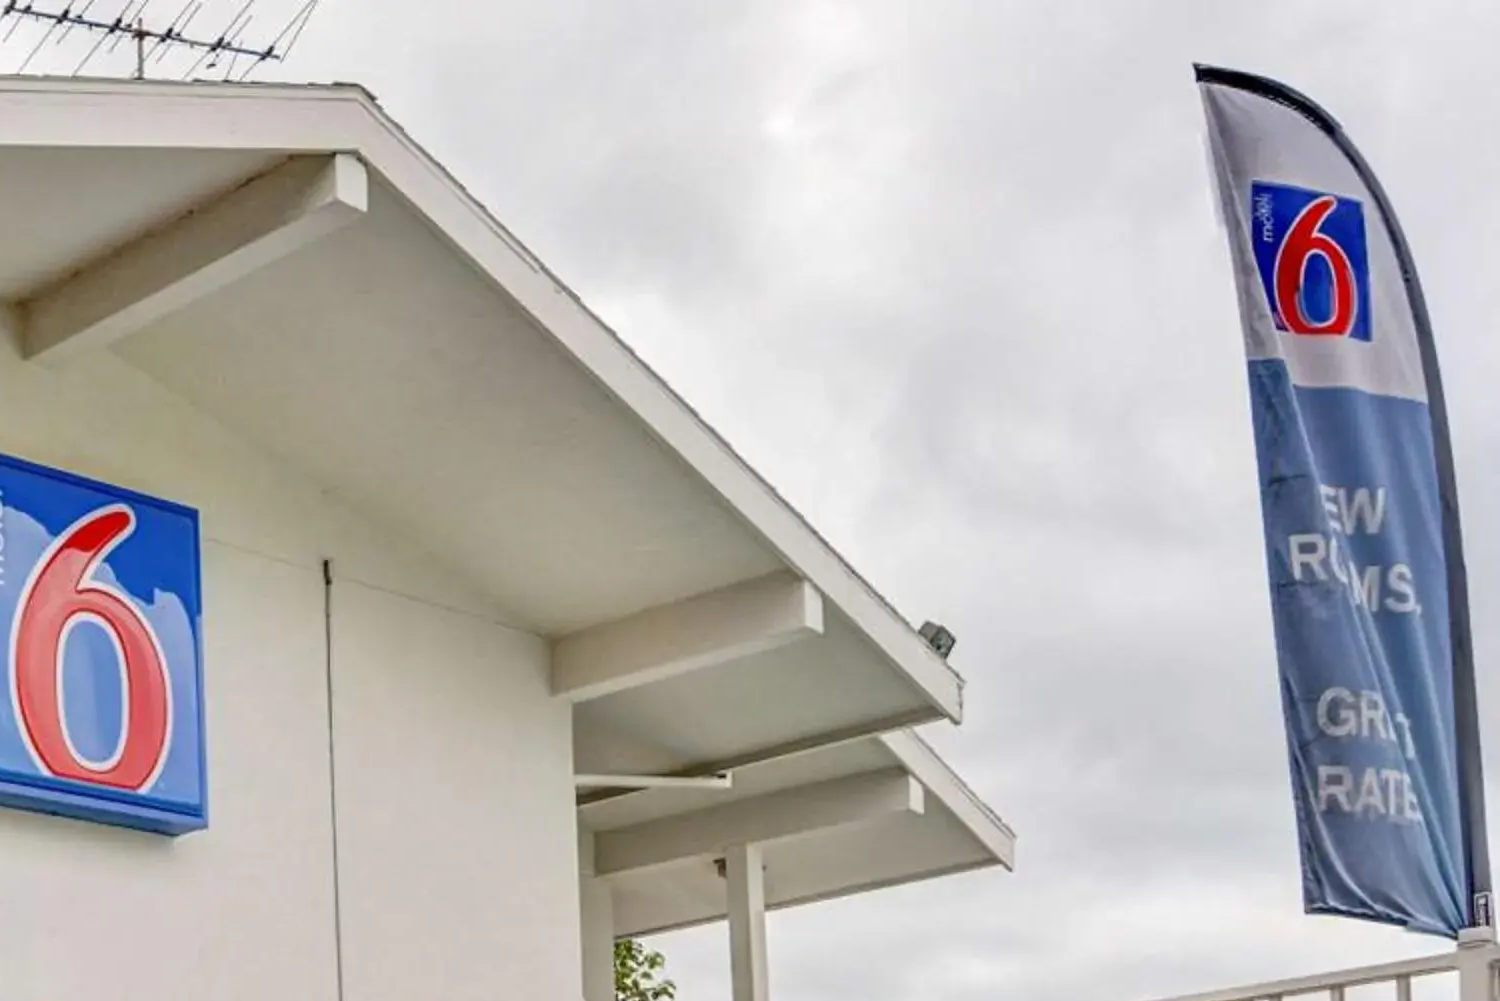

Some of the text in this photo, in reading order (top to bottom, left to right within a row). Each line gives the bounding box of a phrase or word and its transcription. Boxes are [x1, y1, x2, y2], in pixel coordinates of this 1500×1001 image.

[1274, 195, 1358, 336] 6
[1320, 483, 1386, 535] EW
[9, 503, 174, 794] 6
[1317, 765, 1423, 821] RATE
